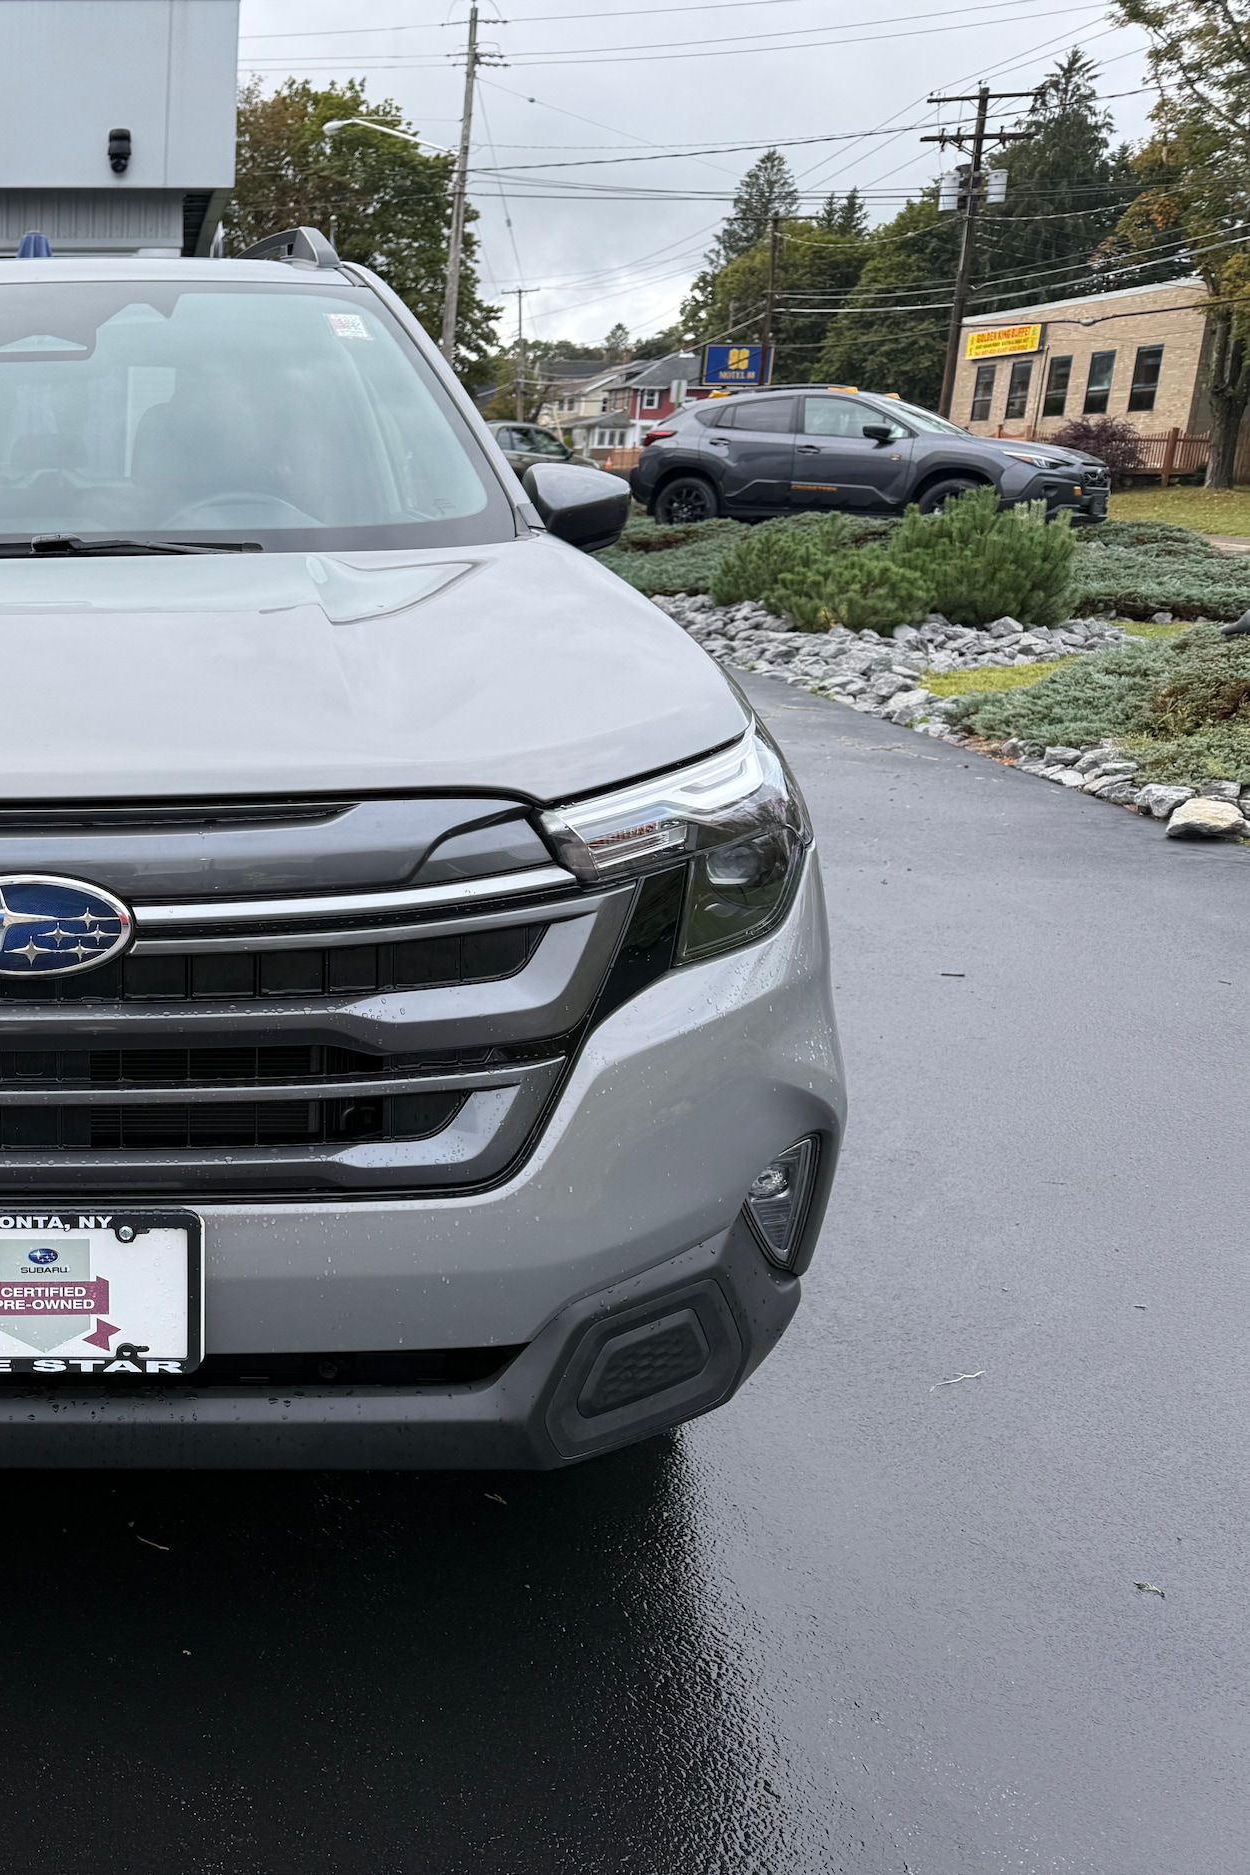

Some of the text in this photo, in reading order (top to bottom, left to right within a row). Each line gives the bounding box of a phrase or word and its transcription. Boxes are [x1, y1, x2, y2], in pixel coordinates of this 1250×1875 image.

[719, 371, 745, 379] MOTEL
[79, 1216, 112, 1228] NY
[1, 1287, 86, 1298] CERTIFIED
[32, 1360, 183, 1374] STAR
